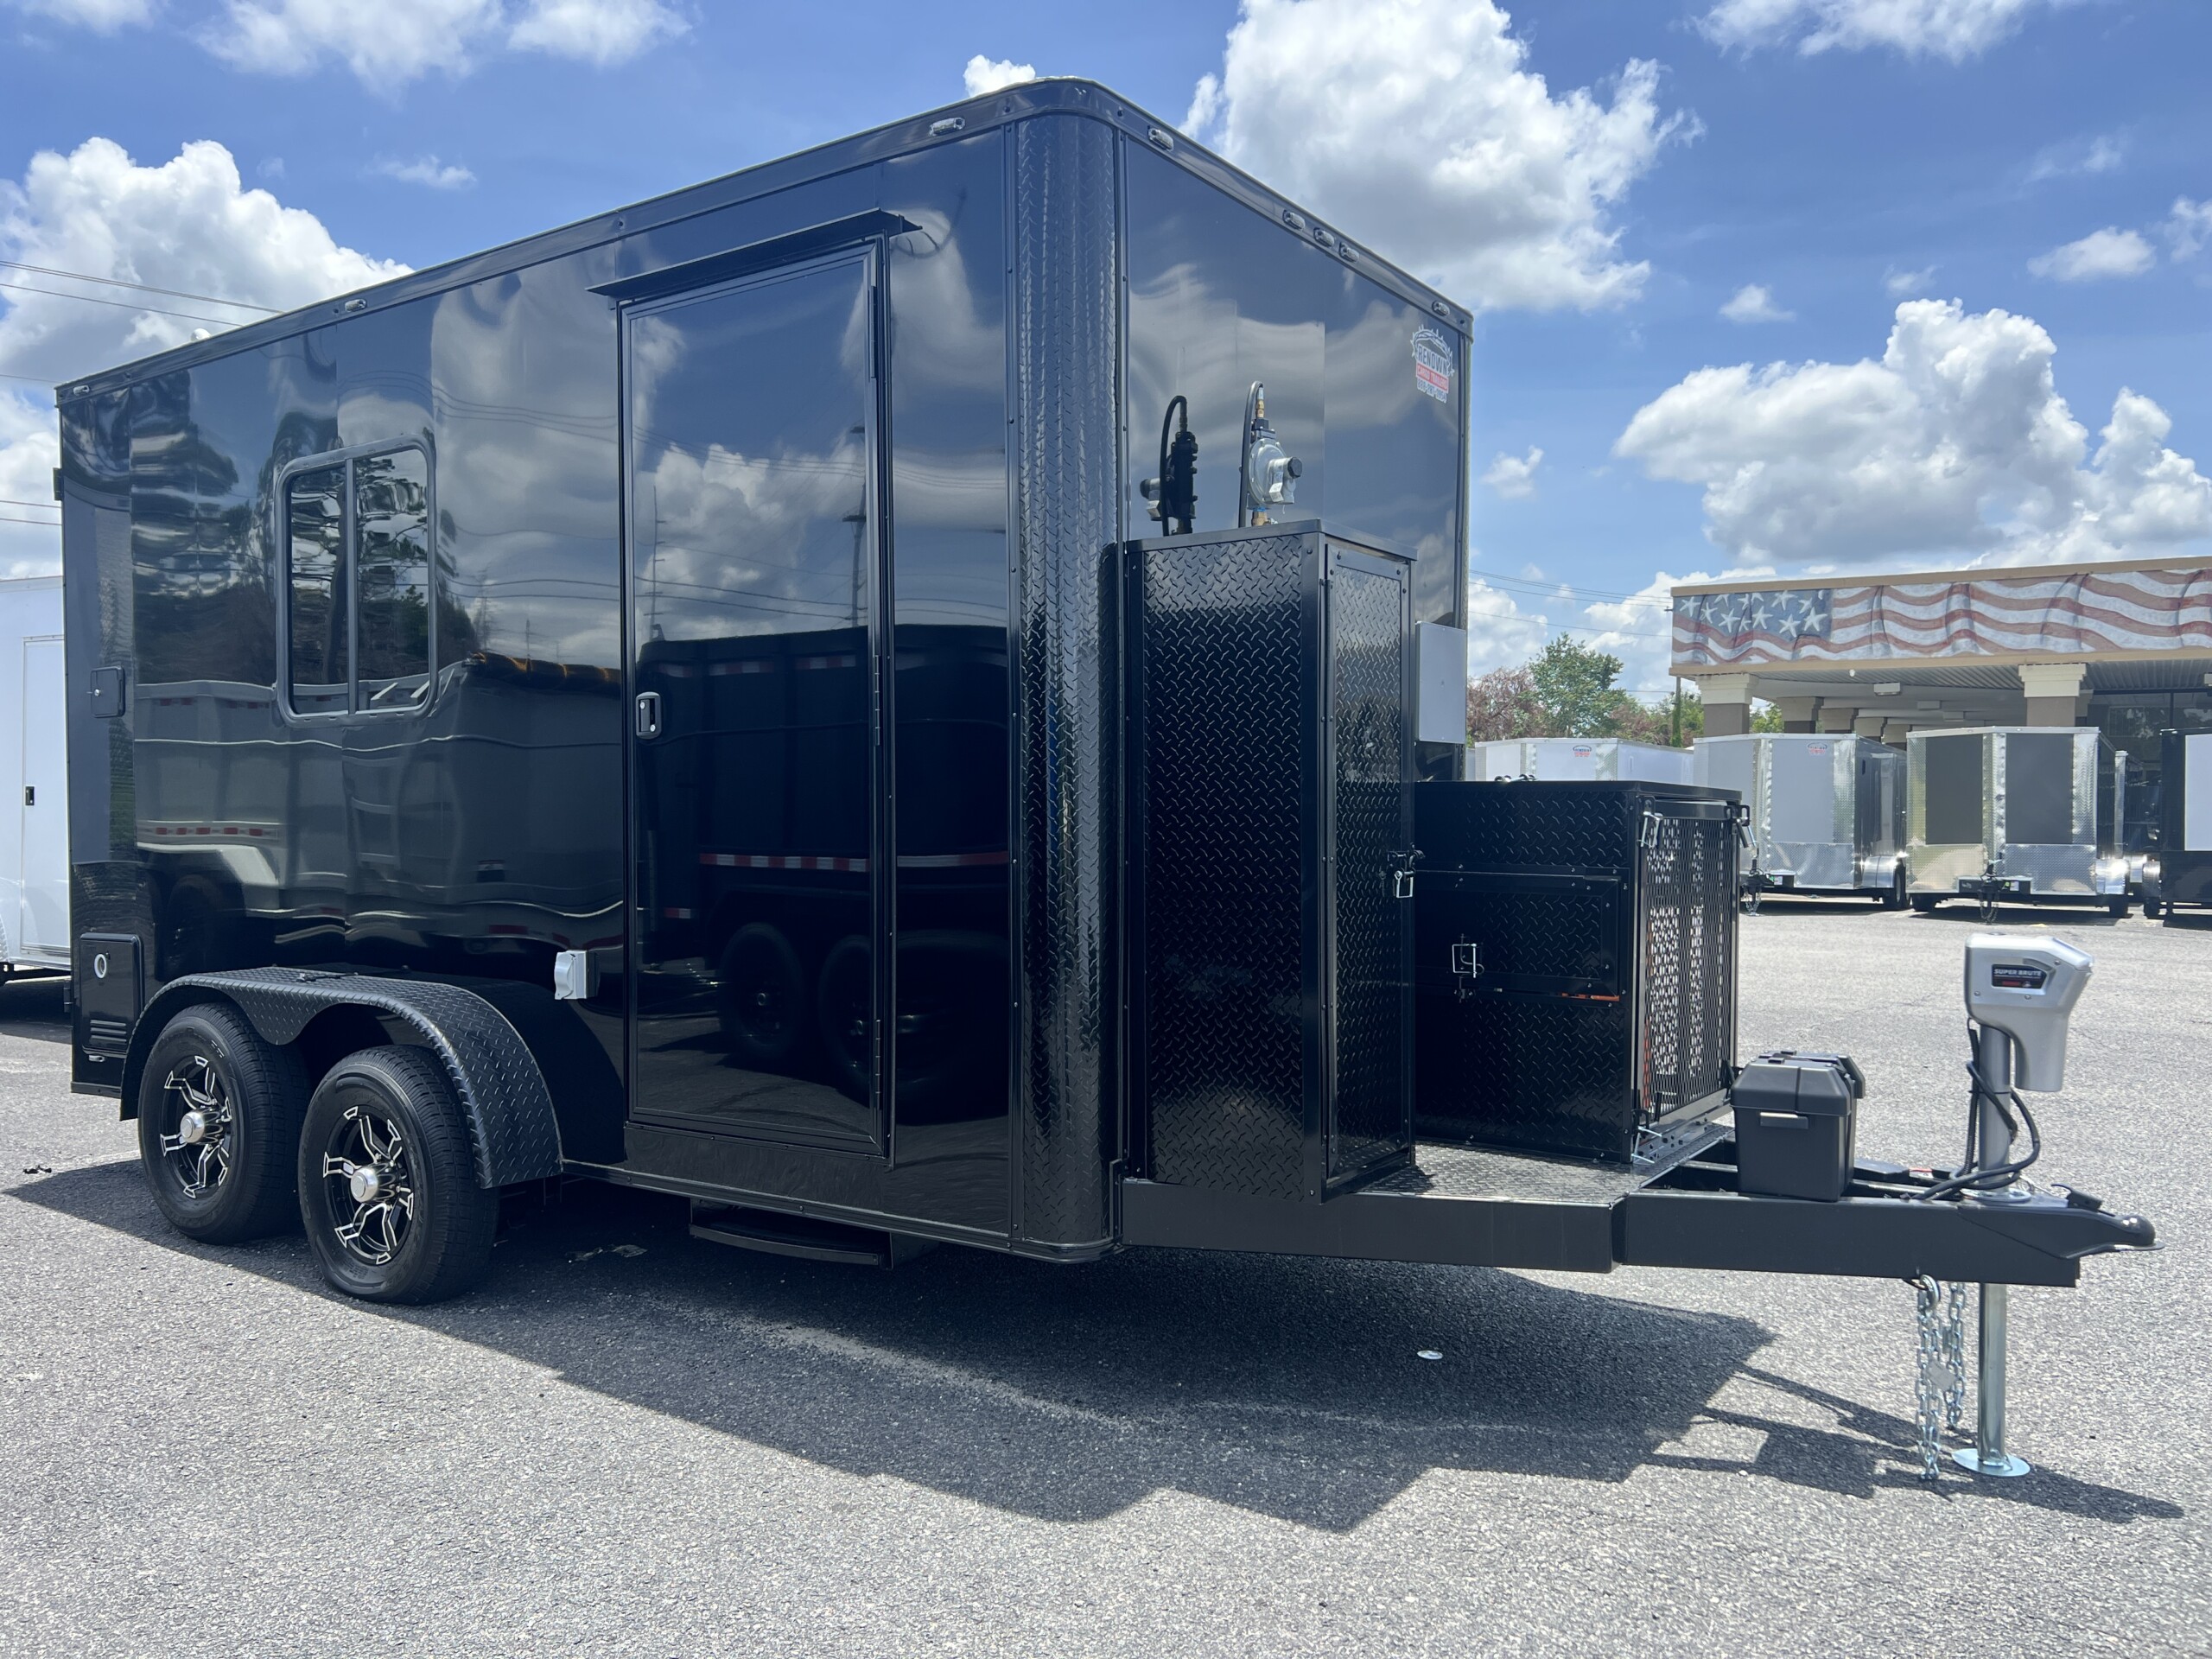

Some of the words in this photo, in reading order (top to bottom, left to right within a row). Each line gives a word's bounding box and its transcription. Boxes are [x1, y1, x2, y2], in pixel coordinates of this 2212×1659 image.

[1418, 345, 1448, 375] RENOWN
[1417, 365, 1431, 379] CARGO
[1431, 372, 1448, 391] TRAILERS
